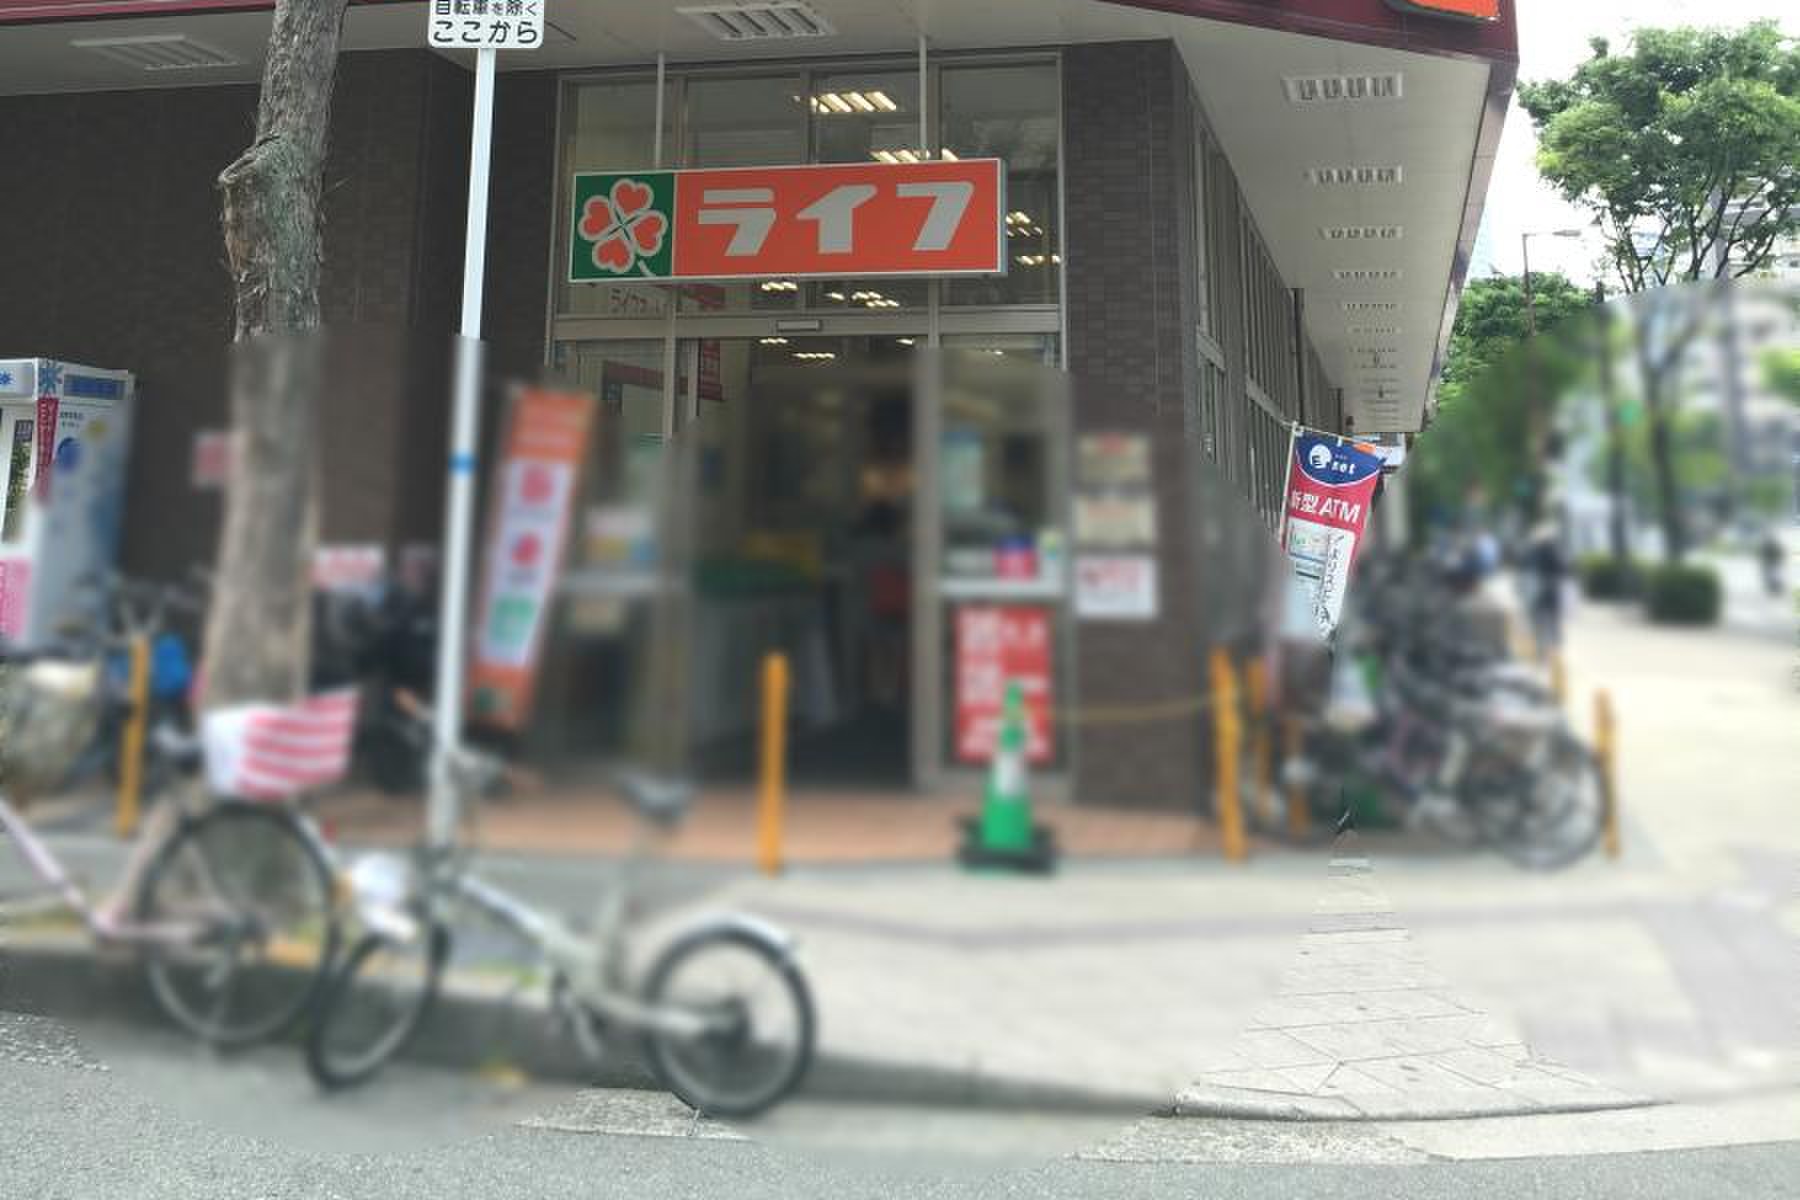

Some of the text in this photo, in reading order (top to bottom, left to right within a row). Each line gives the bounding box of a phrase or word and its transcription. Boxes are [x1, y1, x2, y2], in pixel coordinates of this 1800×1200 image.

[436, 0, 538, 16] 自転車を除く
[433, 20, 538, 44] ここから
[698, 181, 975, 257] ライフ
